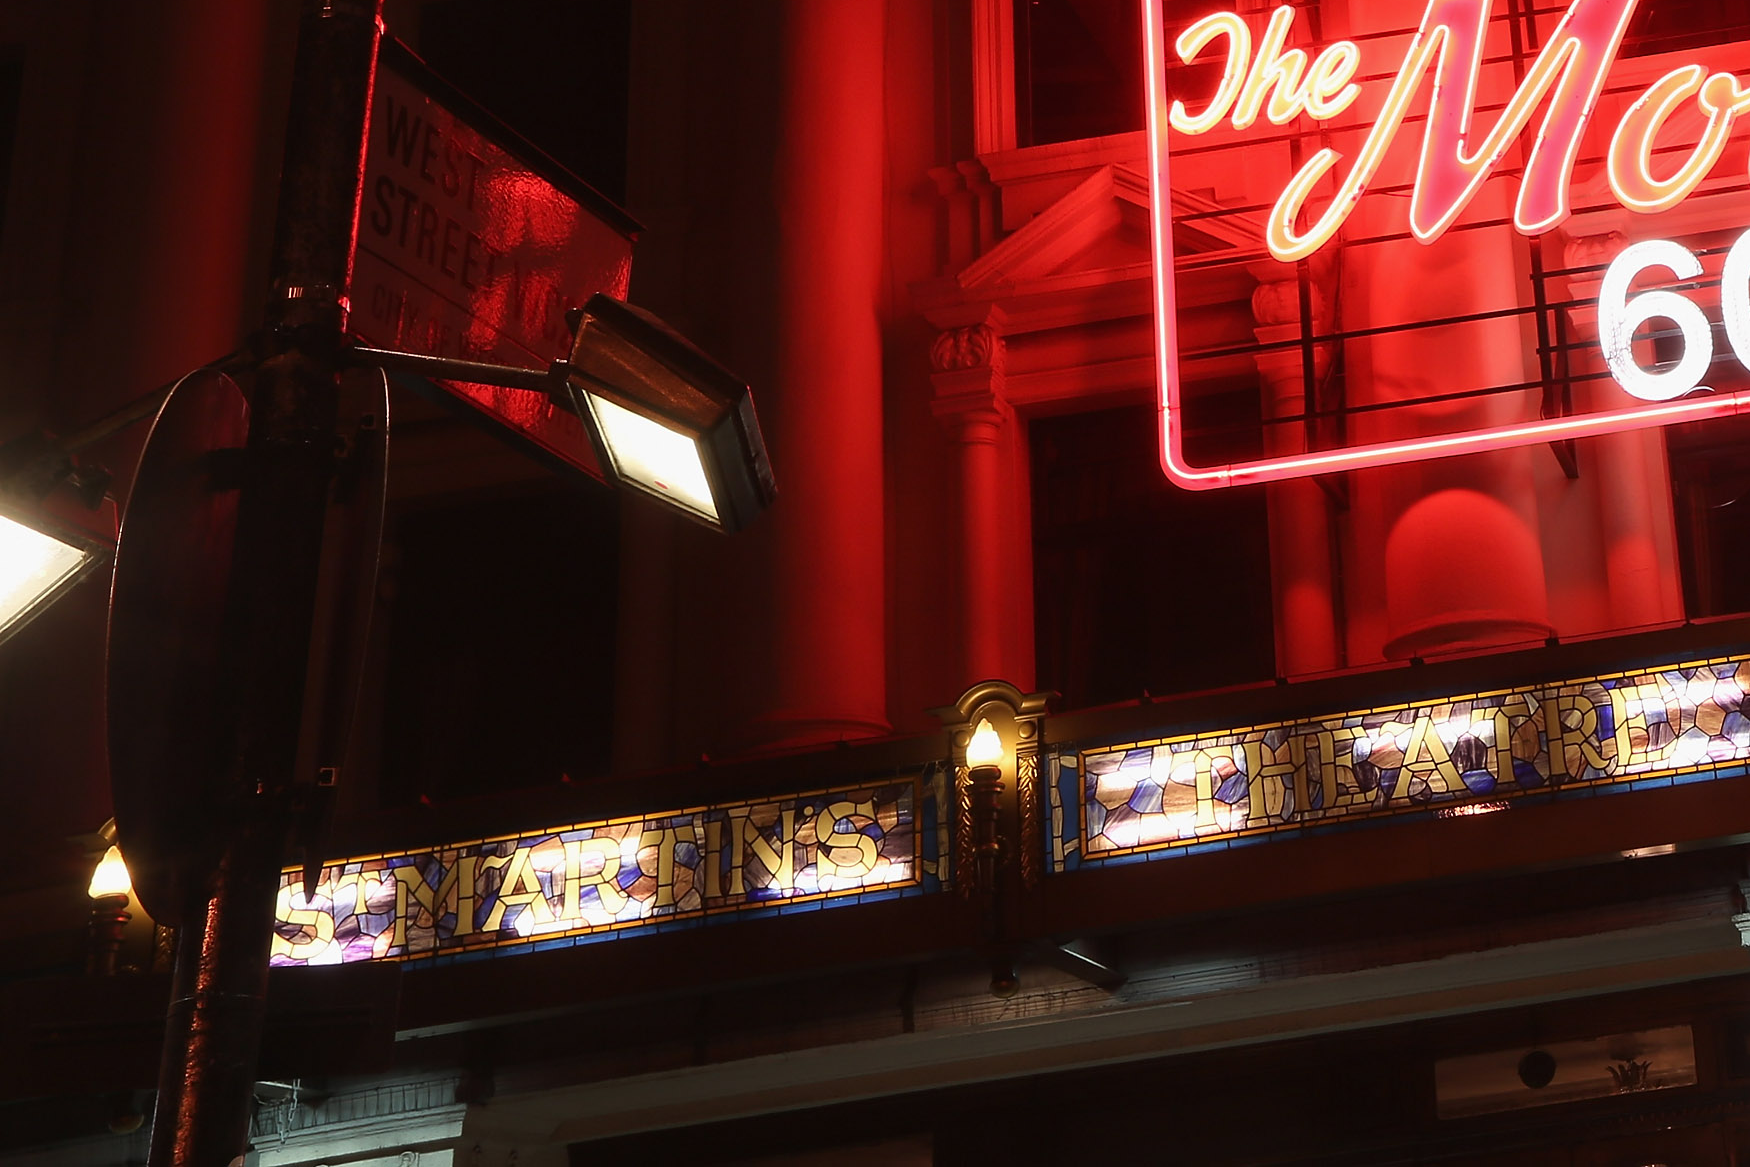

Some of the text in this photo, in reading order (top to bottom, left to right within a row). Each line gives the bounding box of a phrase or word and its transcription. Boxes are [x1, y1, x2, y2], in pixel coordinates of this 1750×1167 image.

[1167, 5, 1363, 136] The
[386, 94, 488, 212] WEST
[370, 173, 502, 299] STREET
[1187, 672, 1681, 832] THEATRE
